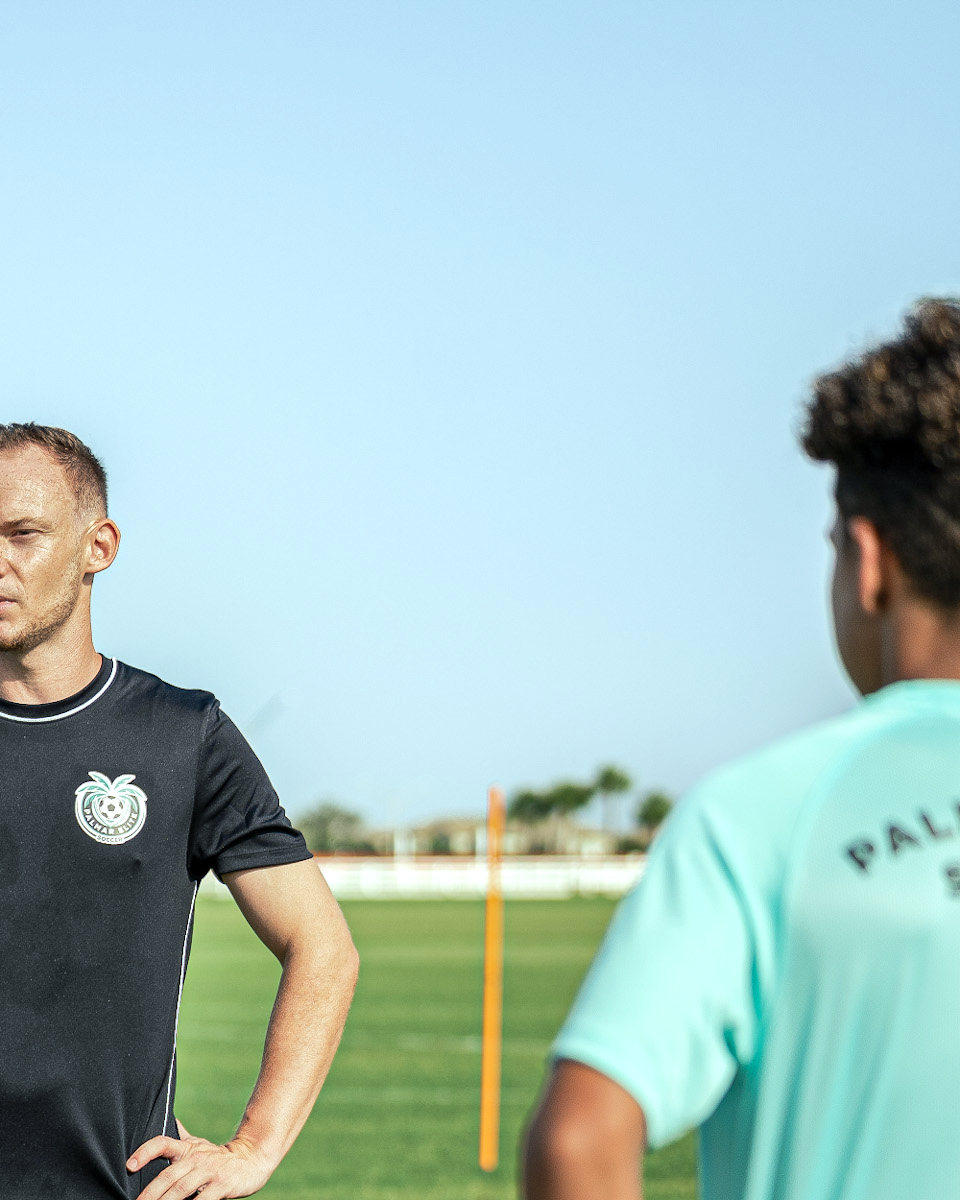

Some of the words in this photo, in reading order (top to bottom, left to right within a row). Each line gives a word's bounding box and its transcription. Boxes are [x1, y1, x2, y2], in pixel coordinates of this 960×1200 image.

[83, 808, 115, 835] PALMAR
[117, 812, 138, 834] ELITE
[844, 796, 960, 873] PAL
[96, 835, 123, 843] SOCCER
